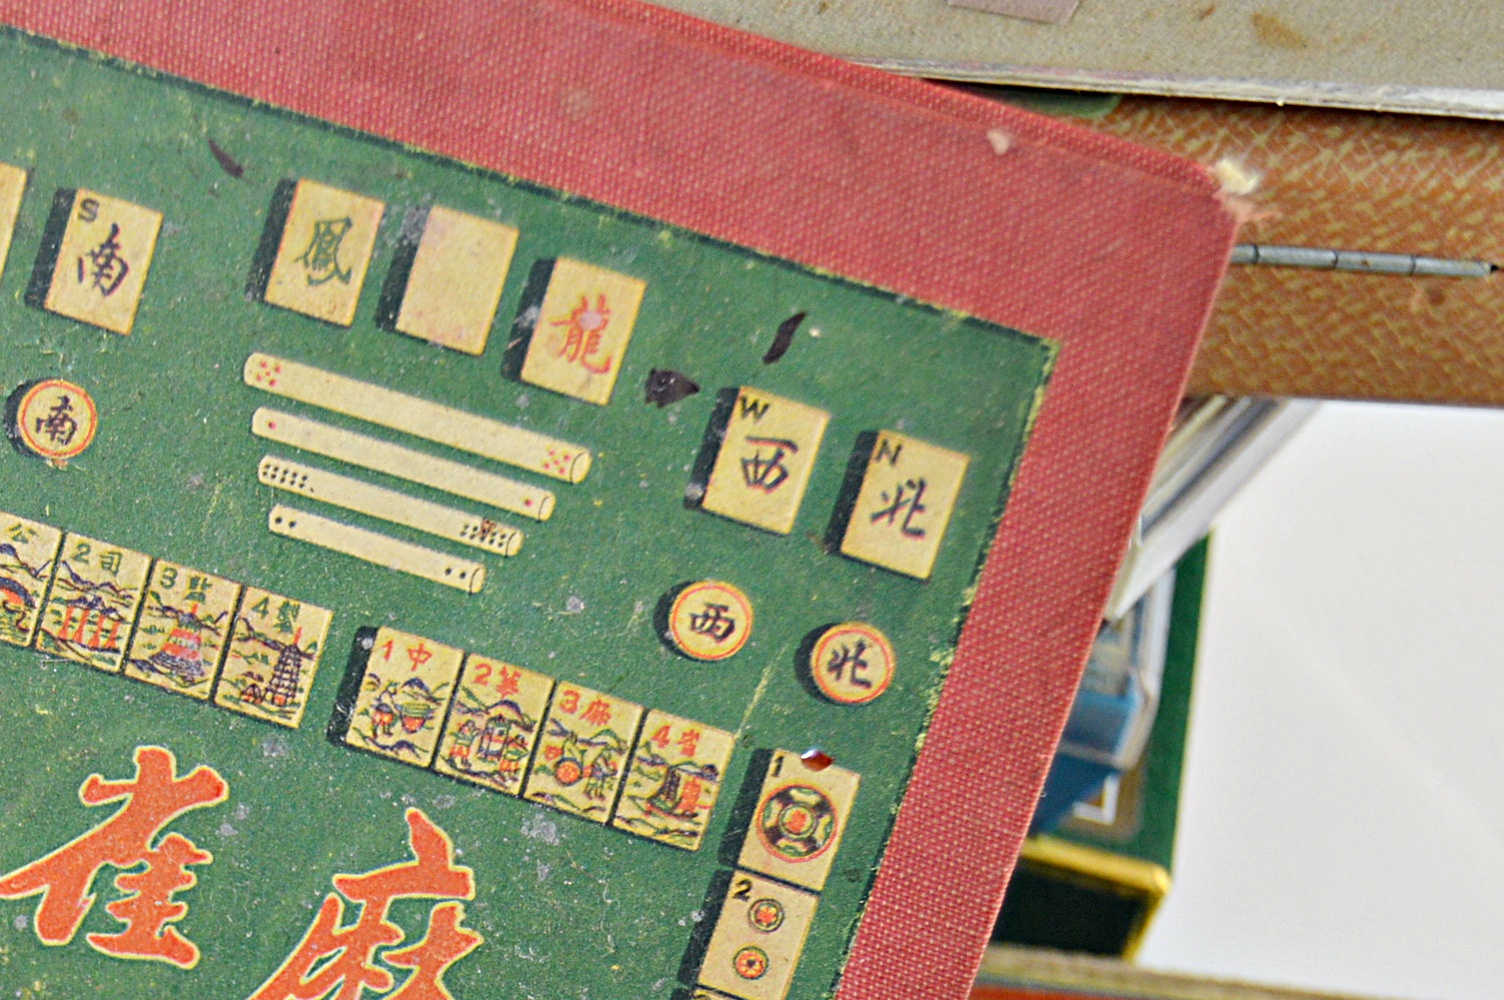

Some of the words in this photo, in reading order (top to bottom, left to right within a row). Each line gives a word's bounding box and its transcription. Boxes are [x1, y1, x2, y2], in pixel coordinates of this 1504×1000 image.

[77, 199, 99, 223] S
[77, 223, 129, 297] 南
[36, 396, 77, 447] 南
[740, 397, 769, 421] W
[740, 436, 798, 493] 西
[876, 439, 903, 465] N
[870, 477, 926, 539] 北
[689, 603, 735, 643] 西
[407, 643, 432, 672] 中
[827, 640, 873, 690] 北
[772, 756, 785, 778] 1
[733, 879, 753, 902] 2
